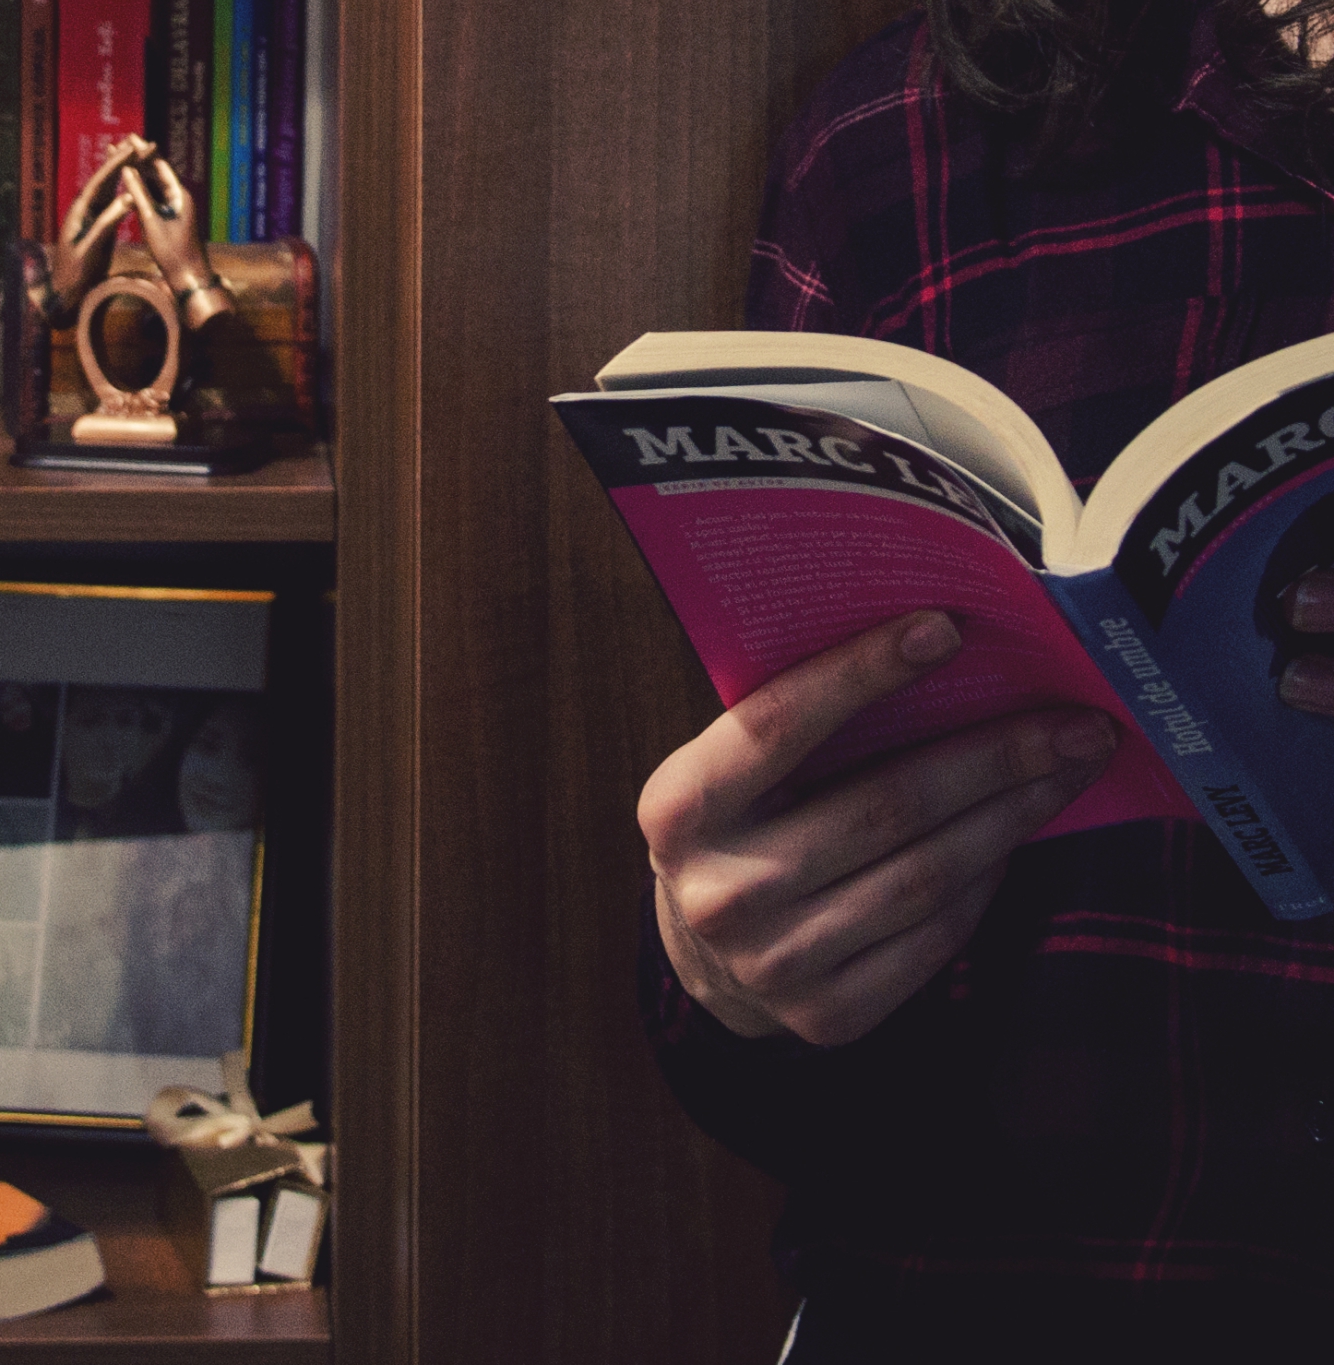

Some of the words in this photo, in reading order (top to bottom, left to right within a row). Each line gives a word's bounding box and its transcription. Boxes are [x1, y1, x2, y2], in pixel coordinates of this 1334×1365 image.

[623, 425, 875, 474] MARC
[1098, 616, 1161, 680] umbre
[1136, 680, 1178, 706] de
[1202, 784, 1247, 826] LEVY
[1233, 823, 1294, 879] MARC
